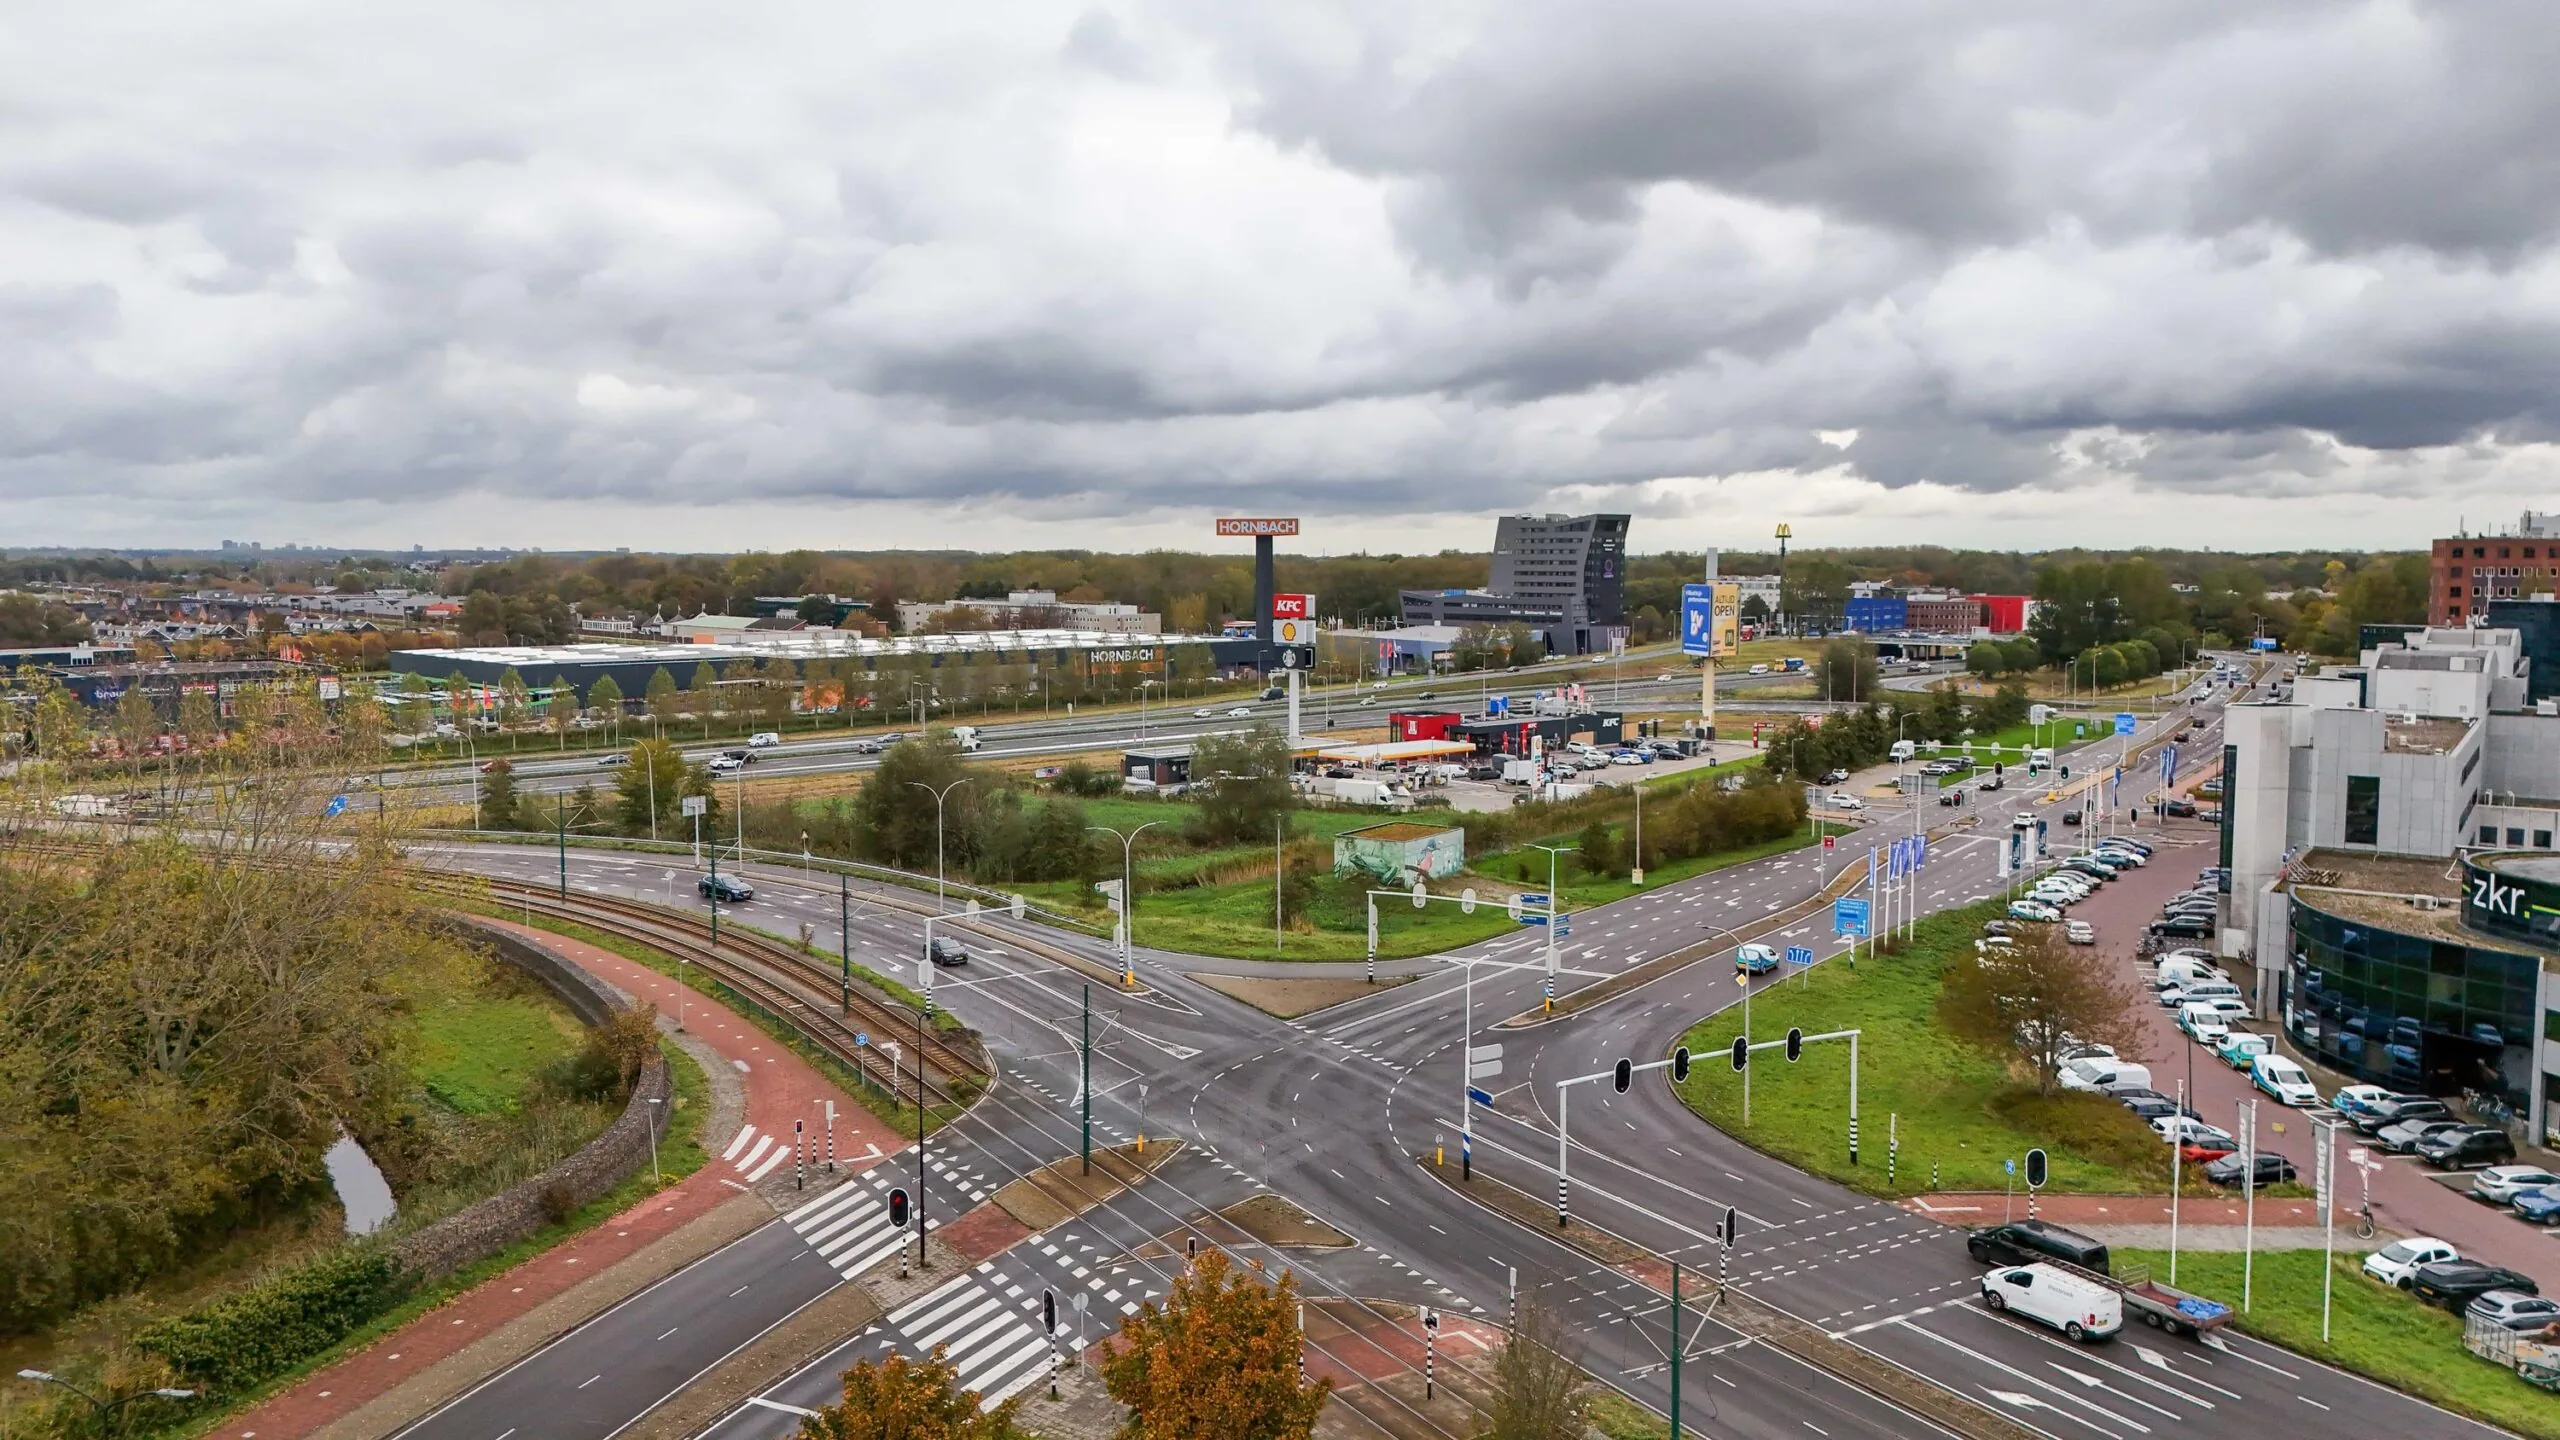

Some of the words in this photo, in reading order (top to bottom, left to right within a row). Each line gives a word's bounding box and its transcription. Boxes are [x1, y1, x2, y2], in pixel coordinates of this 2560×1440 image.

[1219, 521, 1296, 533] HORNBACH
[1276, 600, 1301, 612] KFC
[1714, 605, 1735, 617] OPEN
[1091, 649, 1154, 663] HORNBACH
[1602, 717, 1620, 728] KFC
